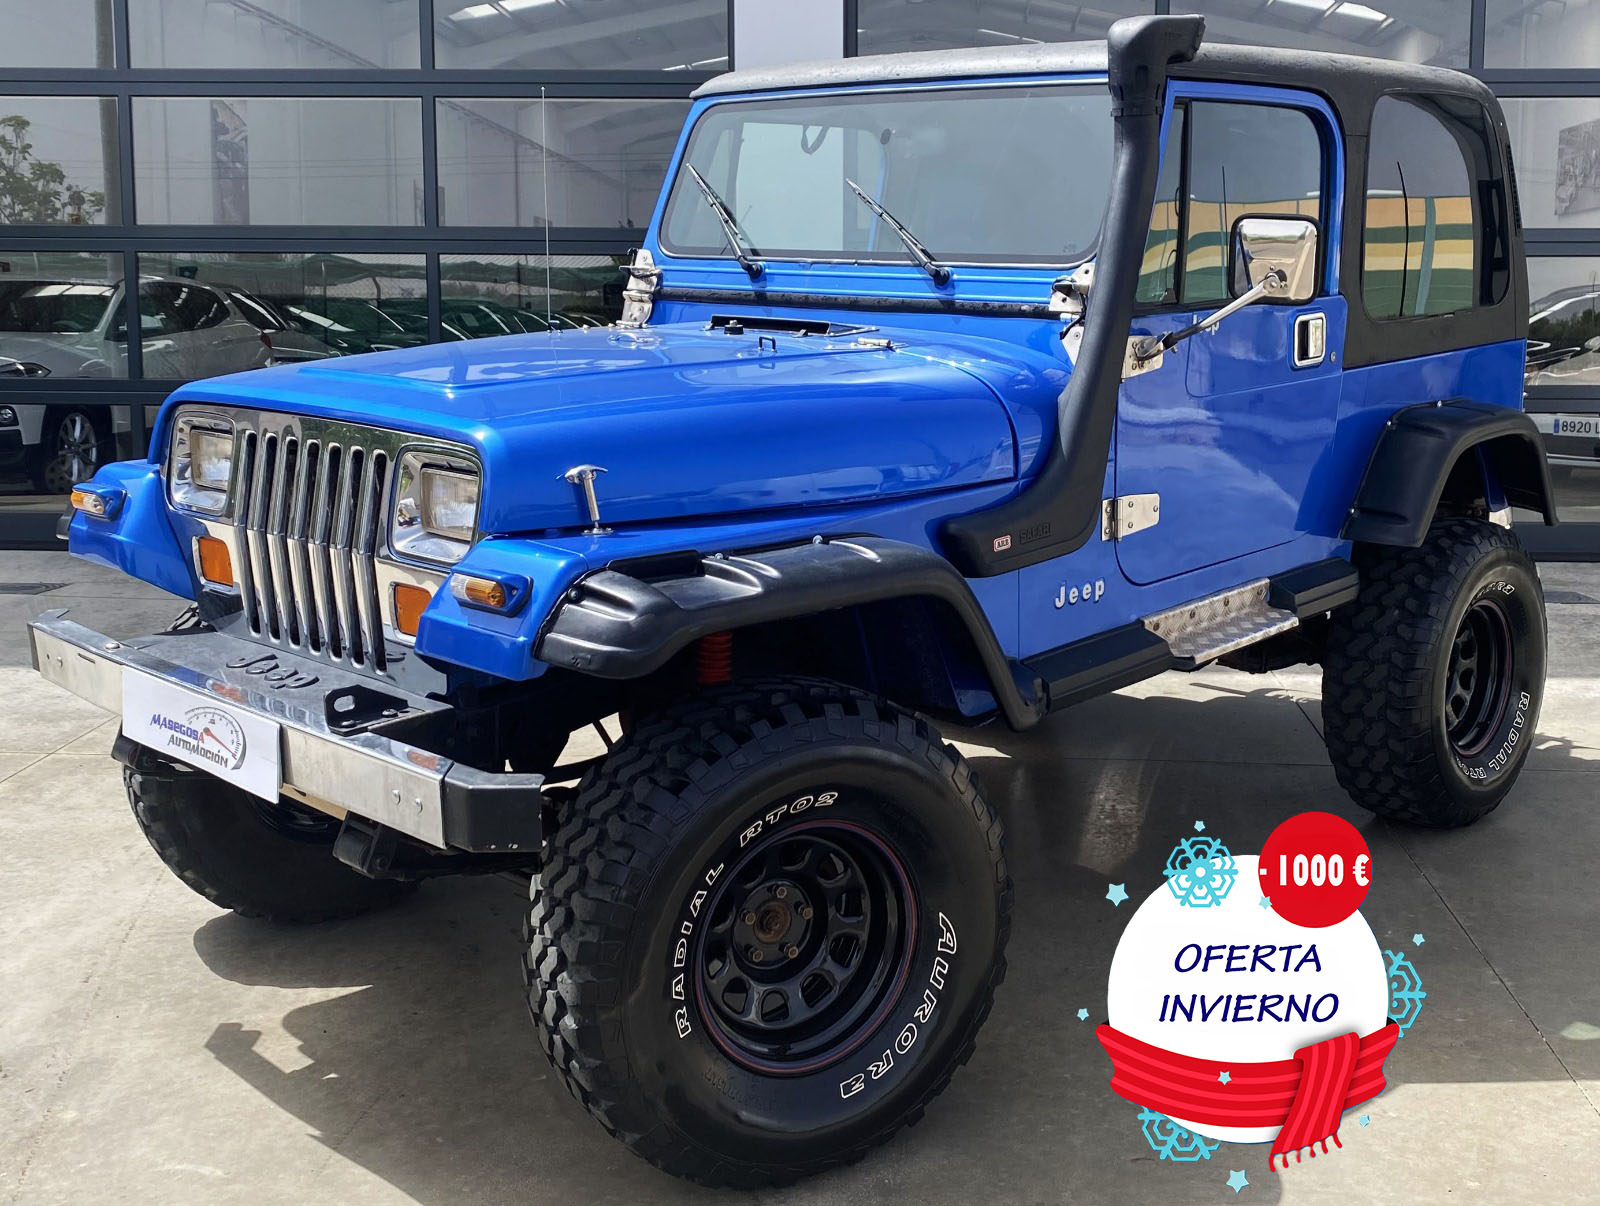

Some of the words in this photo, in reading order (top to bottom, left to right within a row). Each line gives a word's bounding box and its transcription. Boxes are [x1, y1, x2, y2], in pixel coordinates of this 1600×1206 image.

[1561, 420, 1592, 434] 8920
[1055, 579, 1105, 609] Jeep
[225, 653, 321, 690] Jeep
[1488, 691, 1531, 771] RADIAL
[167, 734, 229, 769] AUTOMOCIÓN
[672, 863, 724, 1038] RADIAL
[740, 791, 839, 847] RT02
